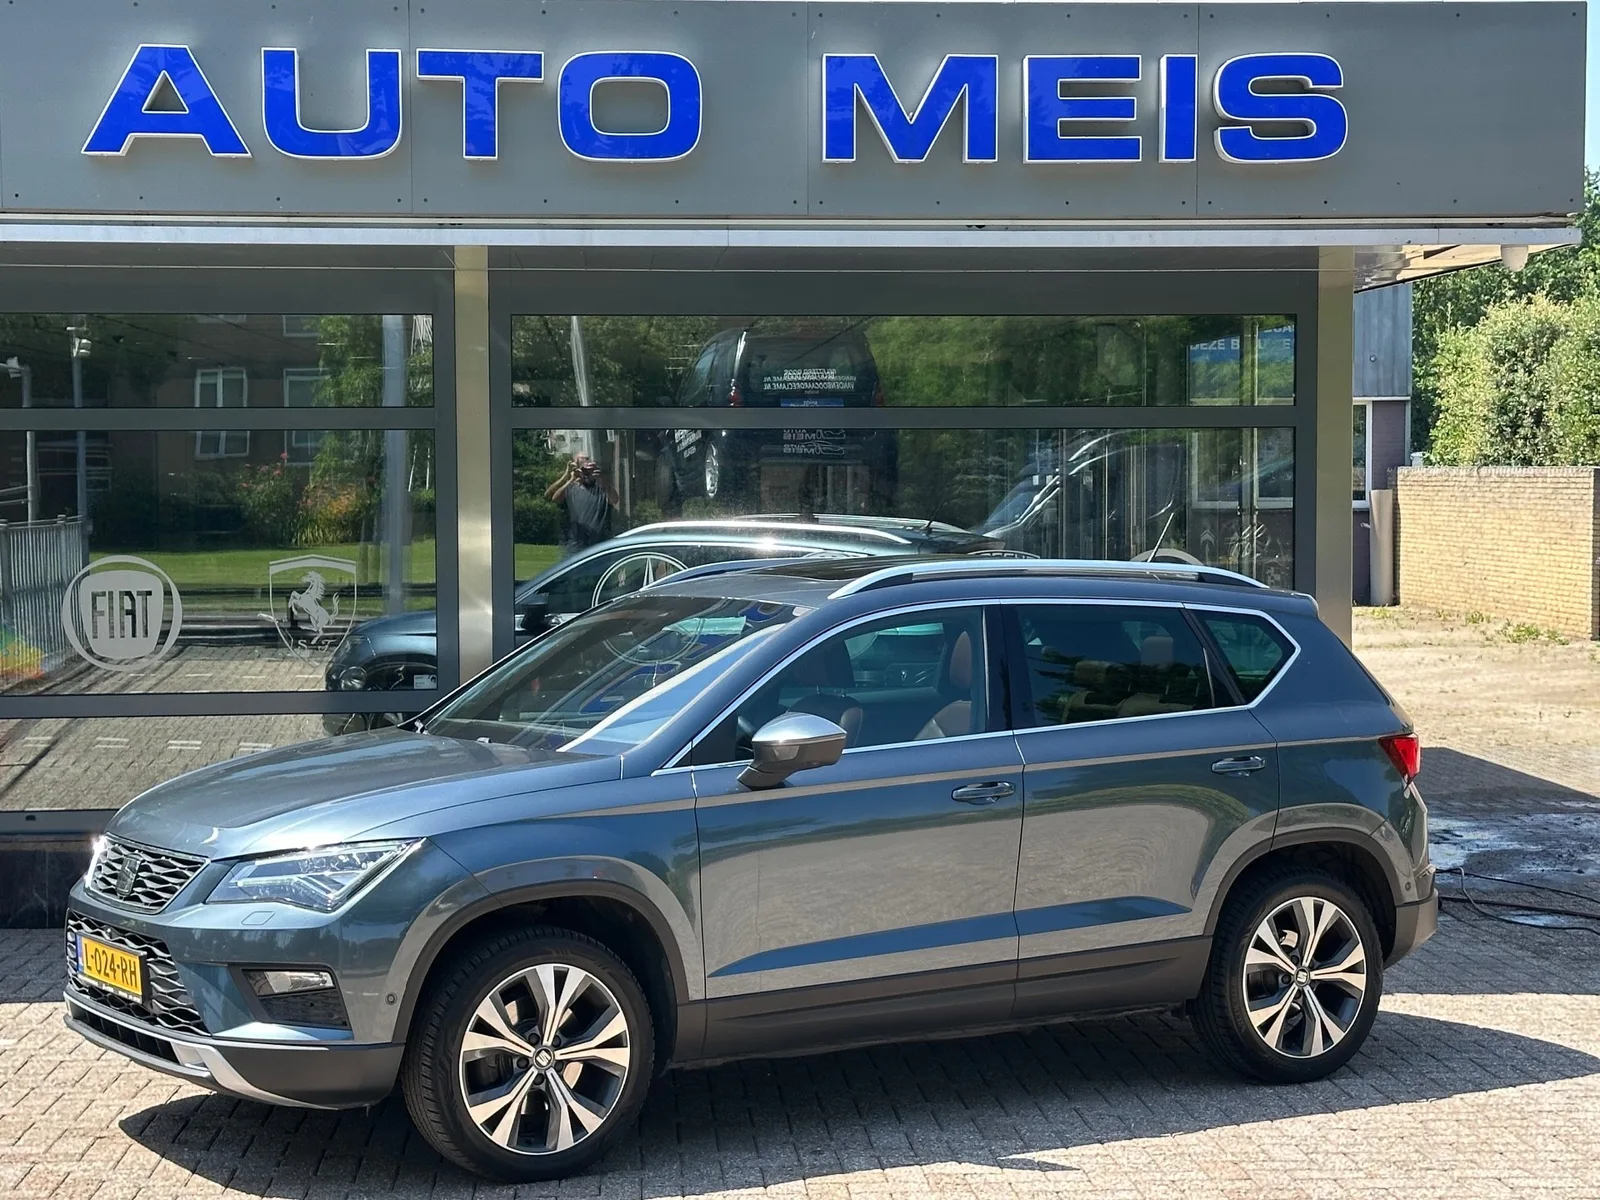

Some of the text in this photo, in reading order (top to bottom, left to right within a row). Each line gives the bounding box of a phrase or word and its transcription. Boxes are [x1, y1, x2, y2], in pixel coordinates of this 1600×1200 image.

[81, 43, 1348, 163] AUTO MEIS
[90, 590, 153, 639] FIAT
[83, 943, 138, 988] L-024-RH
